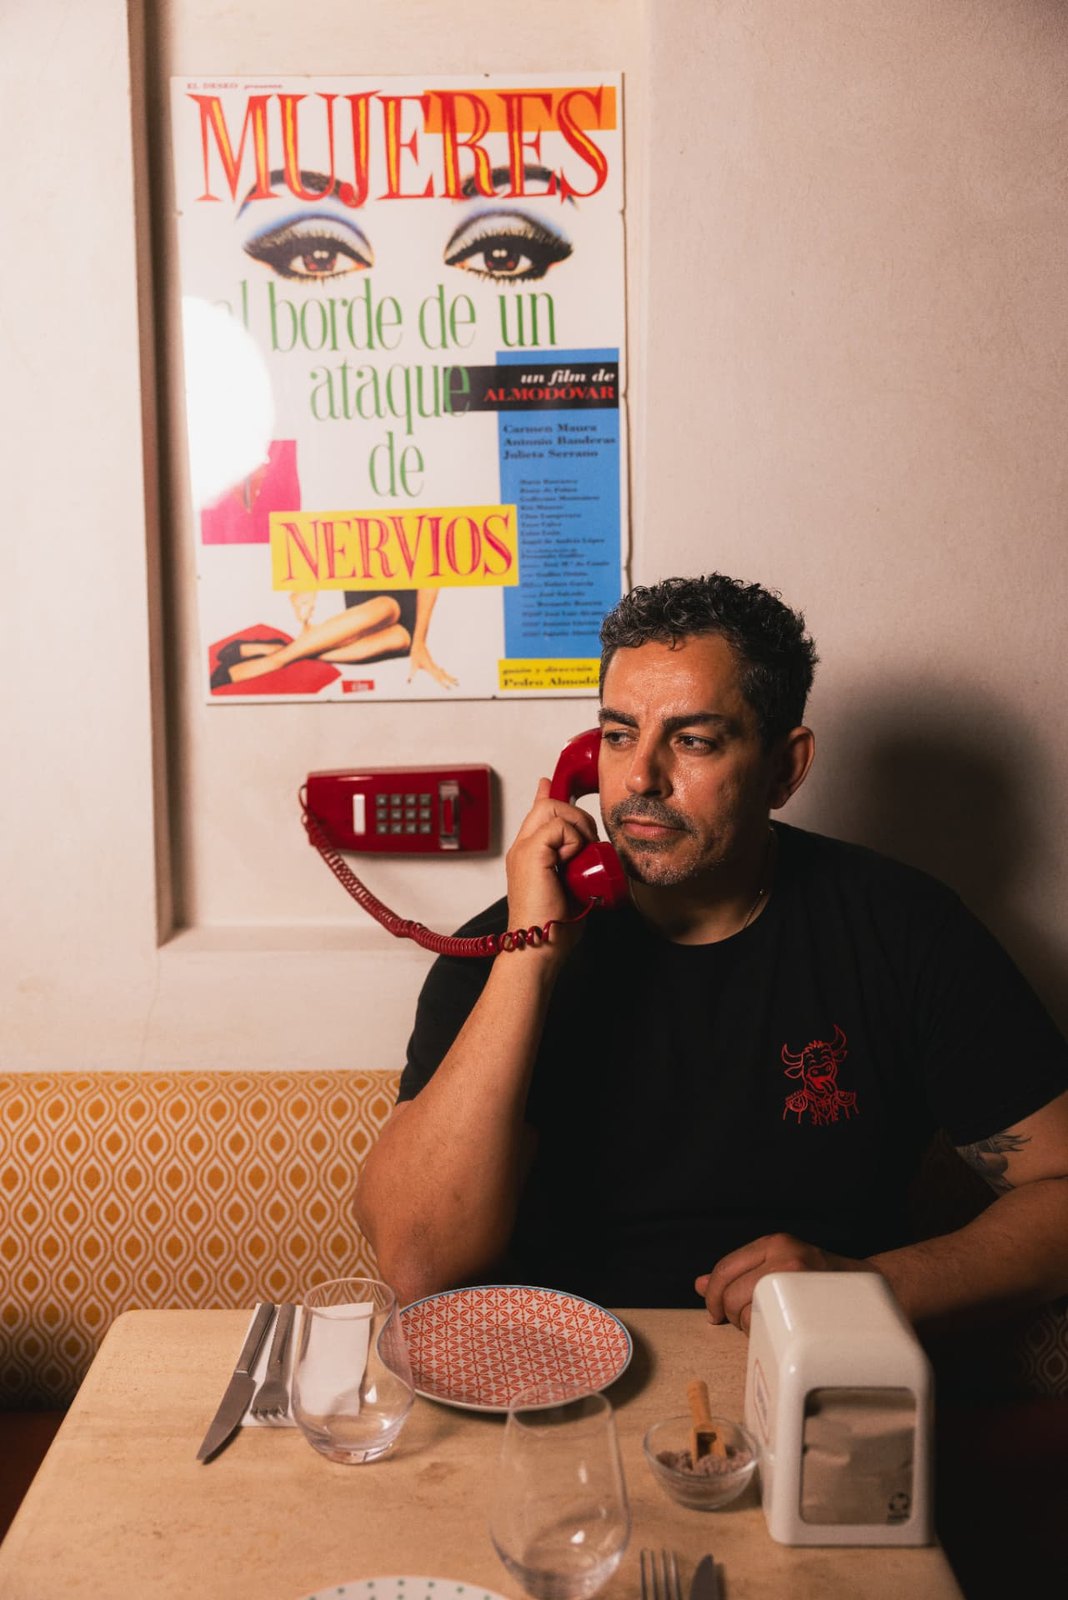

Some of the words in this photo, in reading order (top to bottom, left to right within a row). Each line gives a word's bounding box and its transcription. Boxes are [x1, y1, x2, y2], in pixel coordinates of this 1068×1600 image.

[186, 85, 608, 208] MUJERES
[268, 278, 403, 352] borde
[418, 284, 477, 350] de
[498, 292, 557, 347] un
[521, 374, 545, 384] un
[547, 369, 586, 387] film
[591, 369, 615, 382] de
[309, 358, 471, 435] ataque
[483, 383, 614, 401] ALMODÓVAR
[503, 424, 553, 433] Carmen
[557, 423, 597, 432] Maura
[504, 438, 553, 446] Antonio
[557, 436, 616, 445] Banderas
[503, 450, 545, 460] Julieta
[547, 449, 599, 458] Serrano
[369, 431, 425, 497] de
[280, 512, 513, 581] NERVIOS
[504, 679, 544, 688] Pedro
